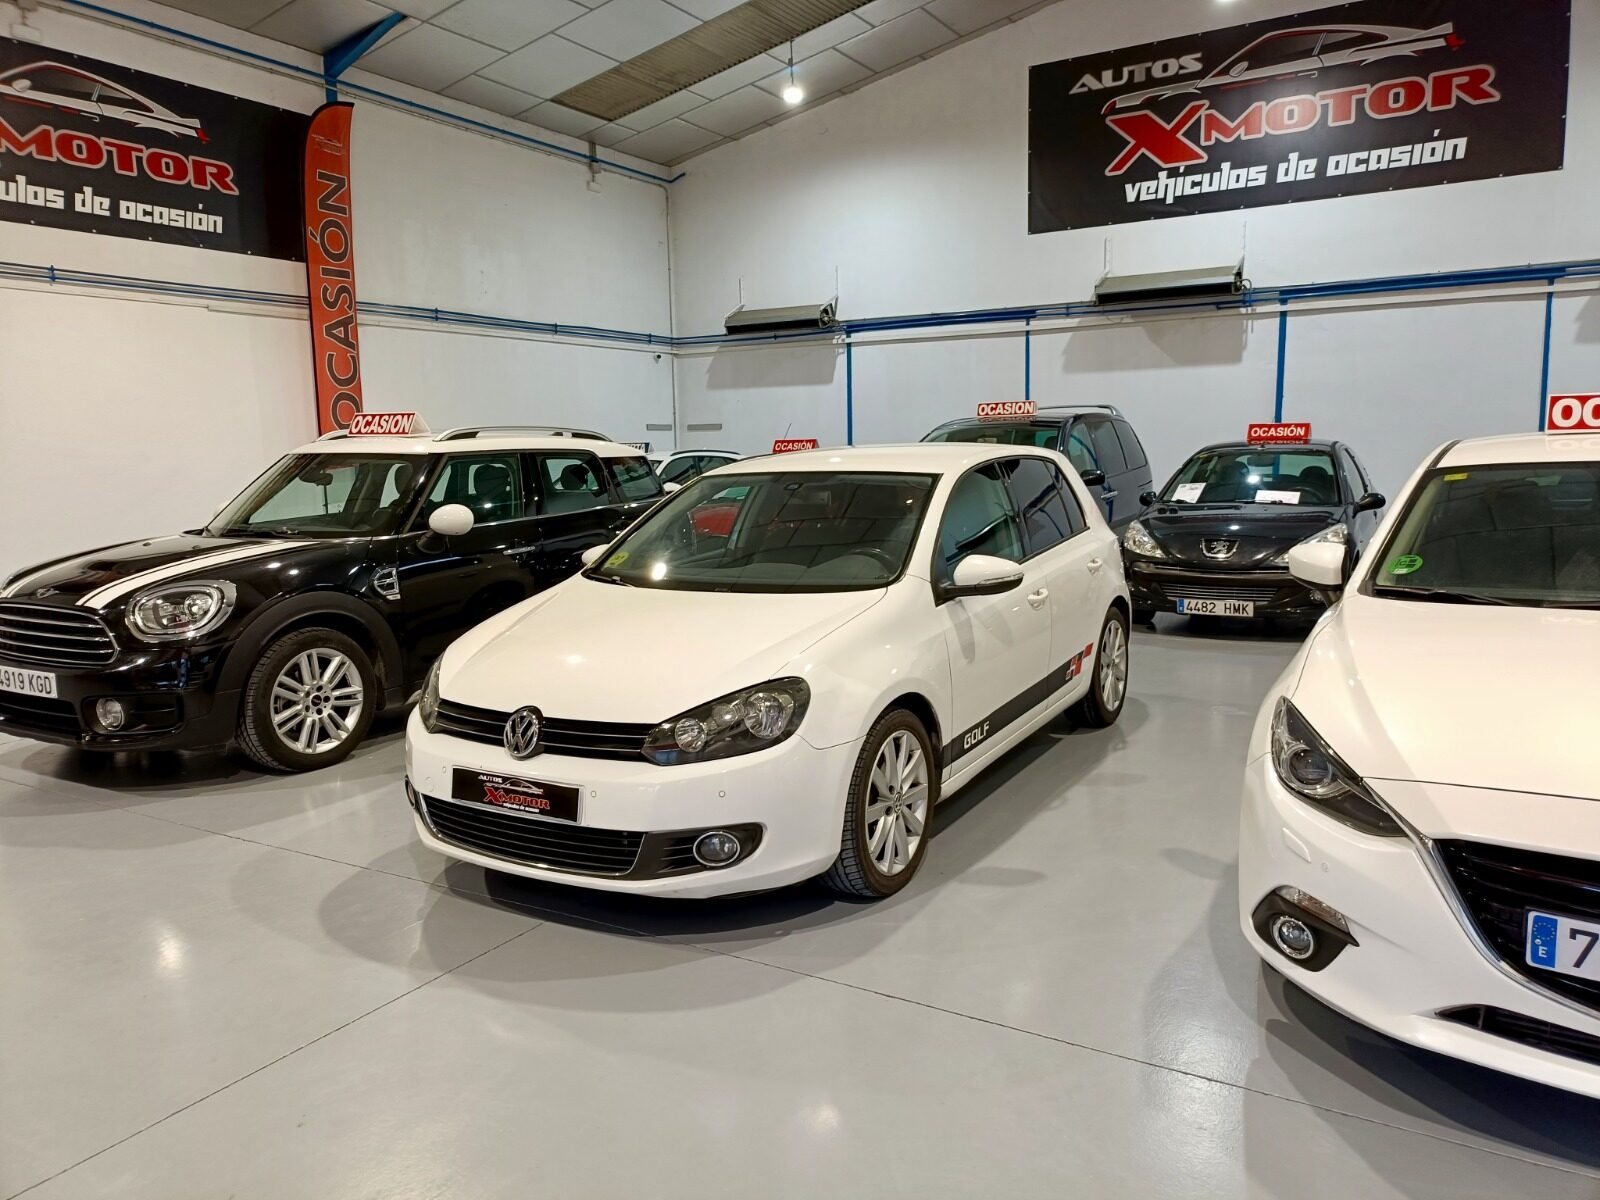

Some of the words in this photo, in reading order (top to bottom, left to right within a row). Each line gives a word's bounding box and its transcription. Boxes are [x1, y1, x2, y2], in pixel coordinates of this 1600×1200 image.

[1068, 52, 1203, 95] AUTOS
[1276, 152, 1318, 184] de
[1326, 128, 1468, 178] ocasión
[74, 185, 111, 217] de
[119, 203, 223, 234] ocasión
[309, 169, 362, 431] OCASIÓN
[978, 402, 1034, 416] OCASION
[351, 414, 414, 434] OCASION
[1250, 424, 1306, 437] OCASIÓN
[1186, 600, 1217, 614] 4482
[1223, 602, 1249, 616] HMK
[27, 673, 52, 695] KGD
[963, 720, 990, 750] GOLF
[478, 774, 503, 784] AUTOS
[1538, 945, 1548, 958] E
[1568, 927, 1600, 969] 7
